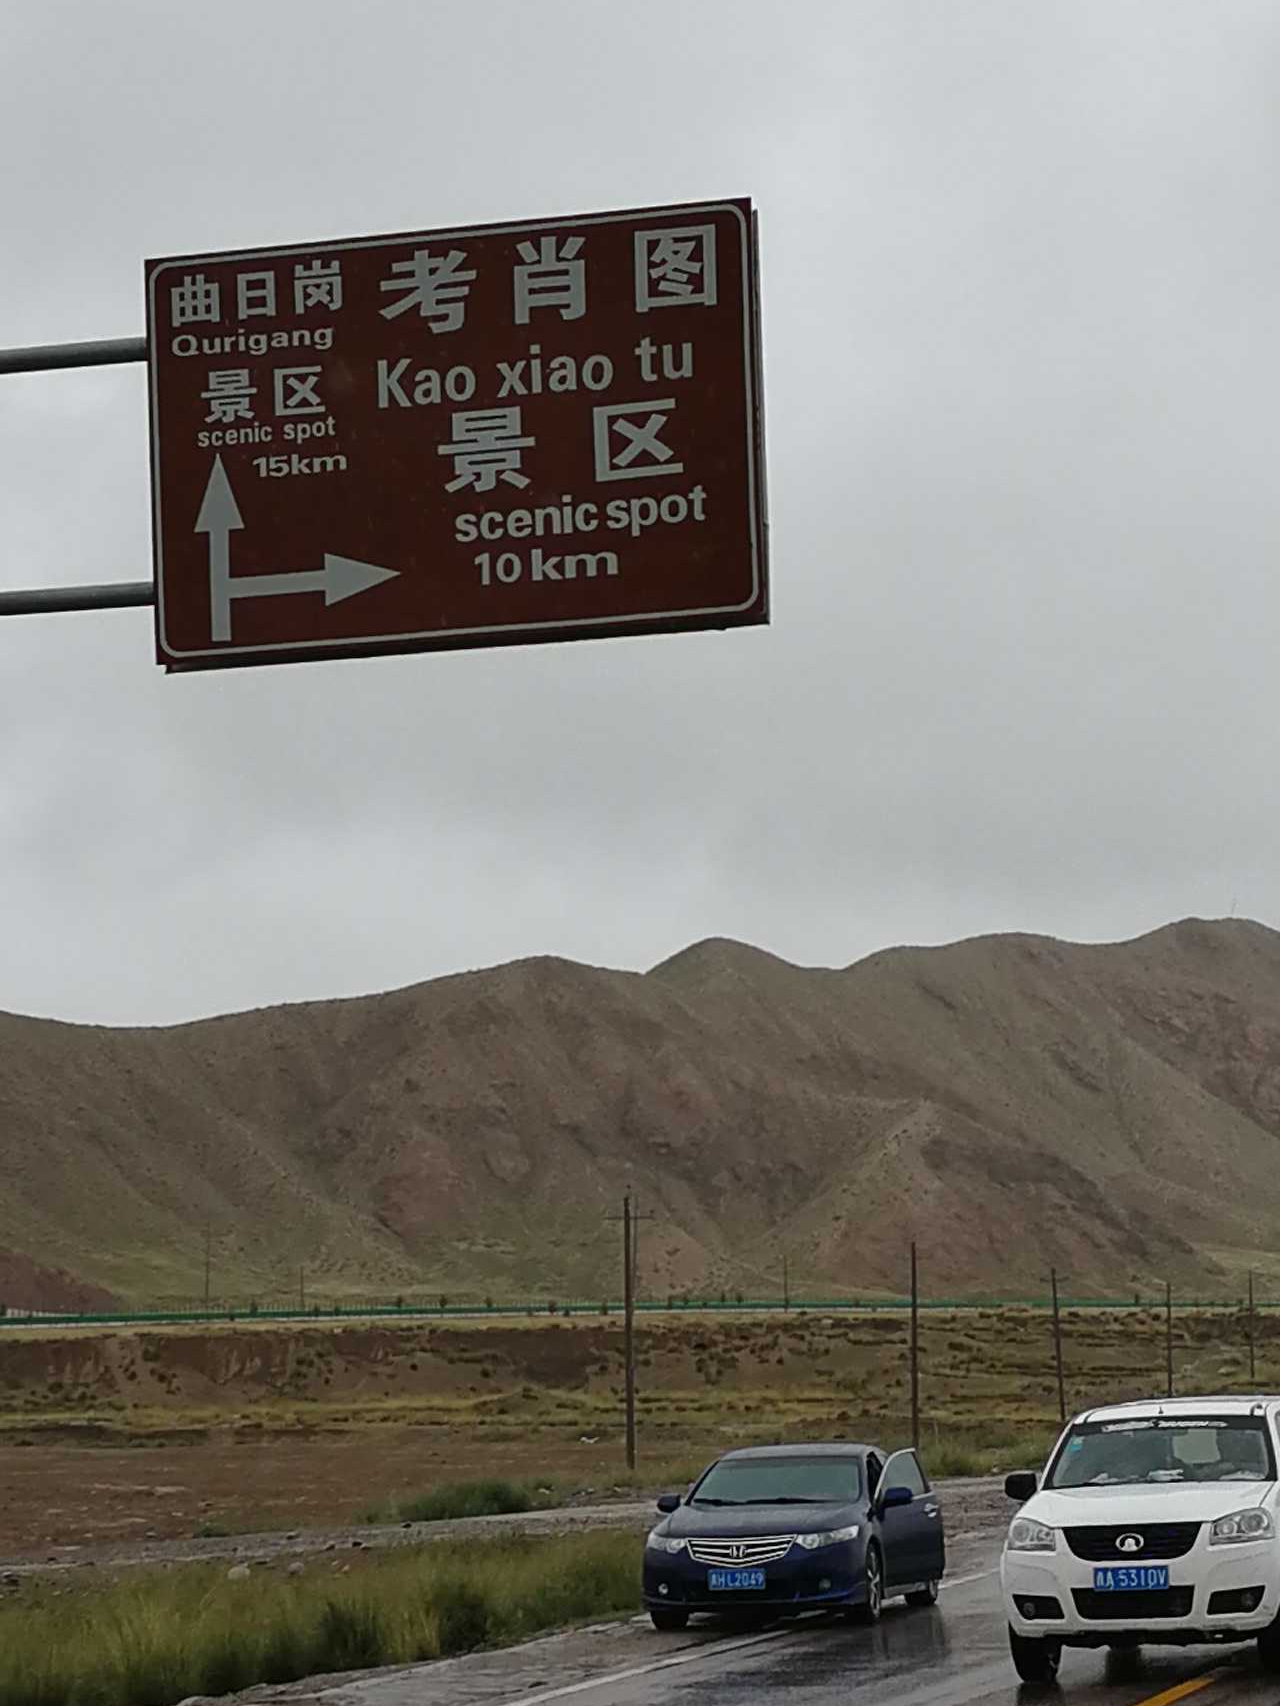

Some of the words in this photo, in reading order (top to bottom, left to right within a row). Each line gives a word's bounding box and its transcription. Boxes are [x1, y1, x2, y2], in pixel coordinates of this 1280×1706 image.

[171, 260, 343, 327] 曲日岗
[378, 224, 717, 334] 考肖图
[172, 327, 334, 357] Qurigang
[200, 365, 326, 423] 景区
[377, 358, 476, 408] Kao
[496, 344, 614, 398] xiao
[634, 336, 693, 381] tu
[198, 422, 272, 447] scenic
[283, 416, 336, 444] spot
[437, 398, 684, 493] 景区
[252, 453, 347, 477] 15km
[455, 495, 599, 542] scenic
[606, 485, 707, 536] spot
